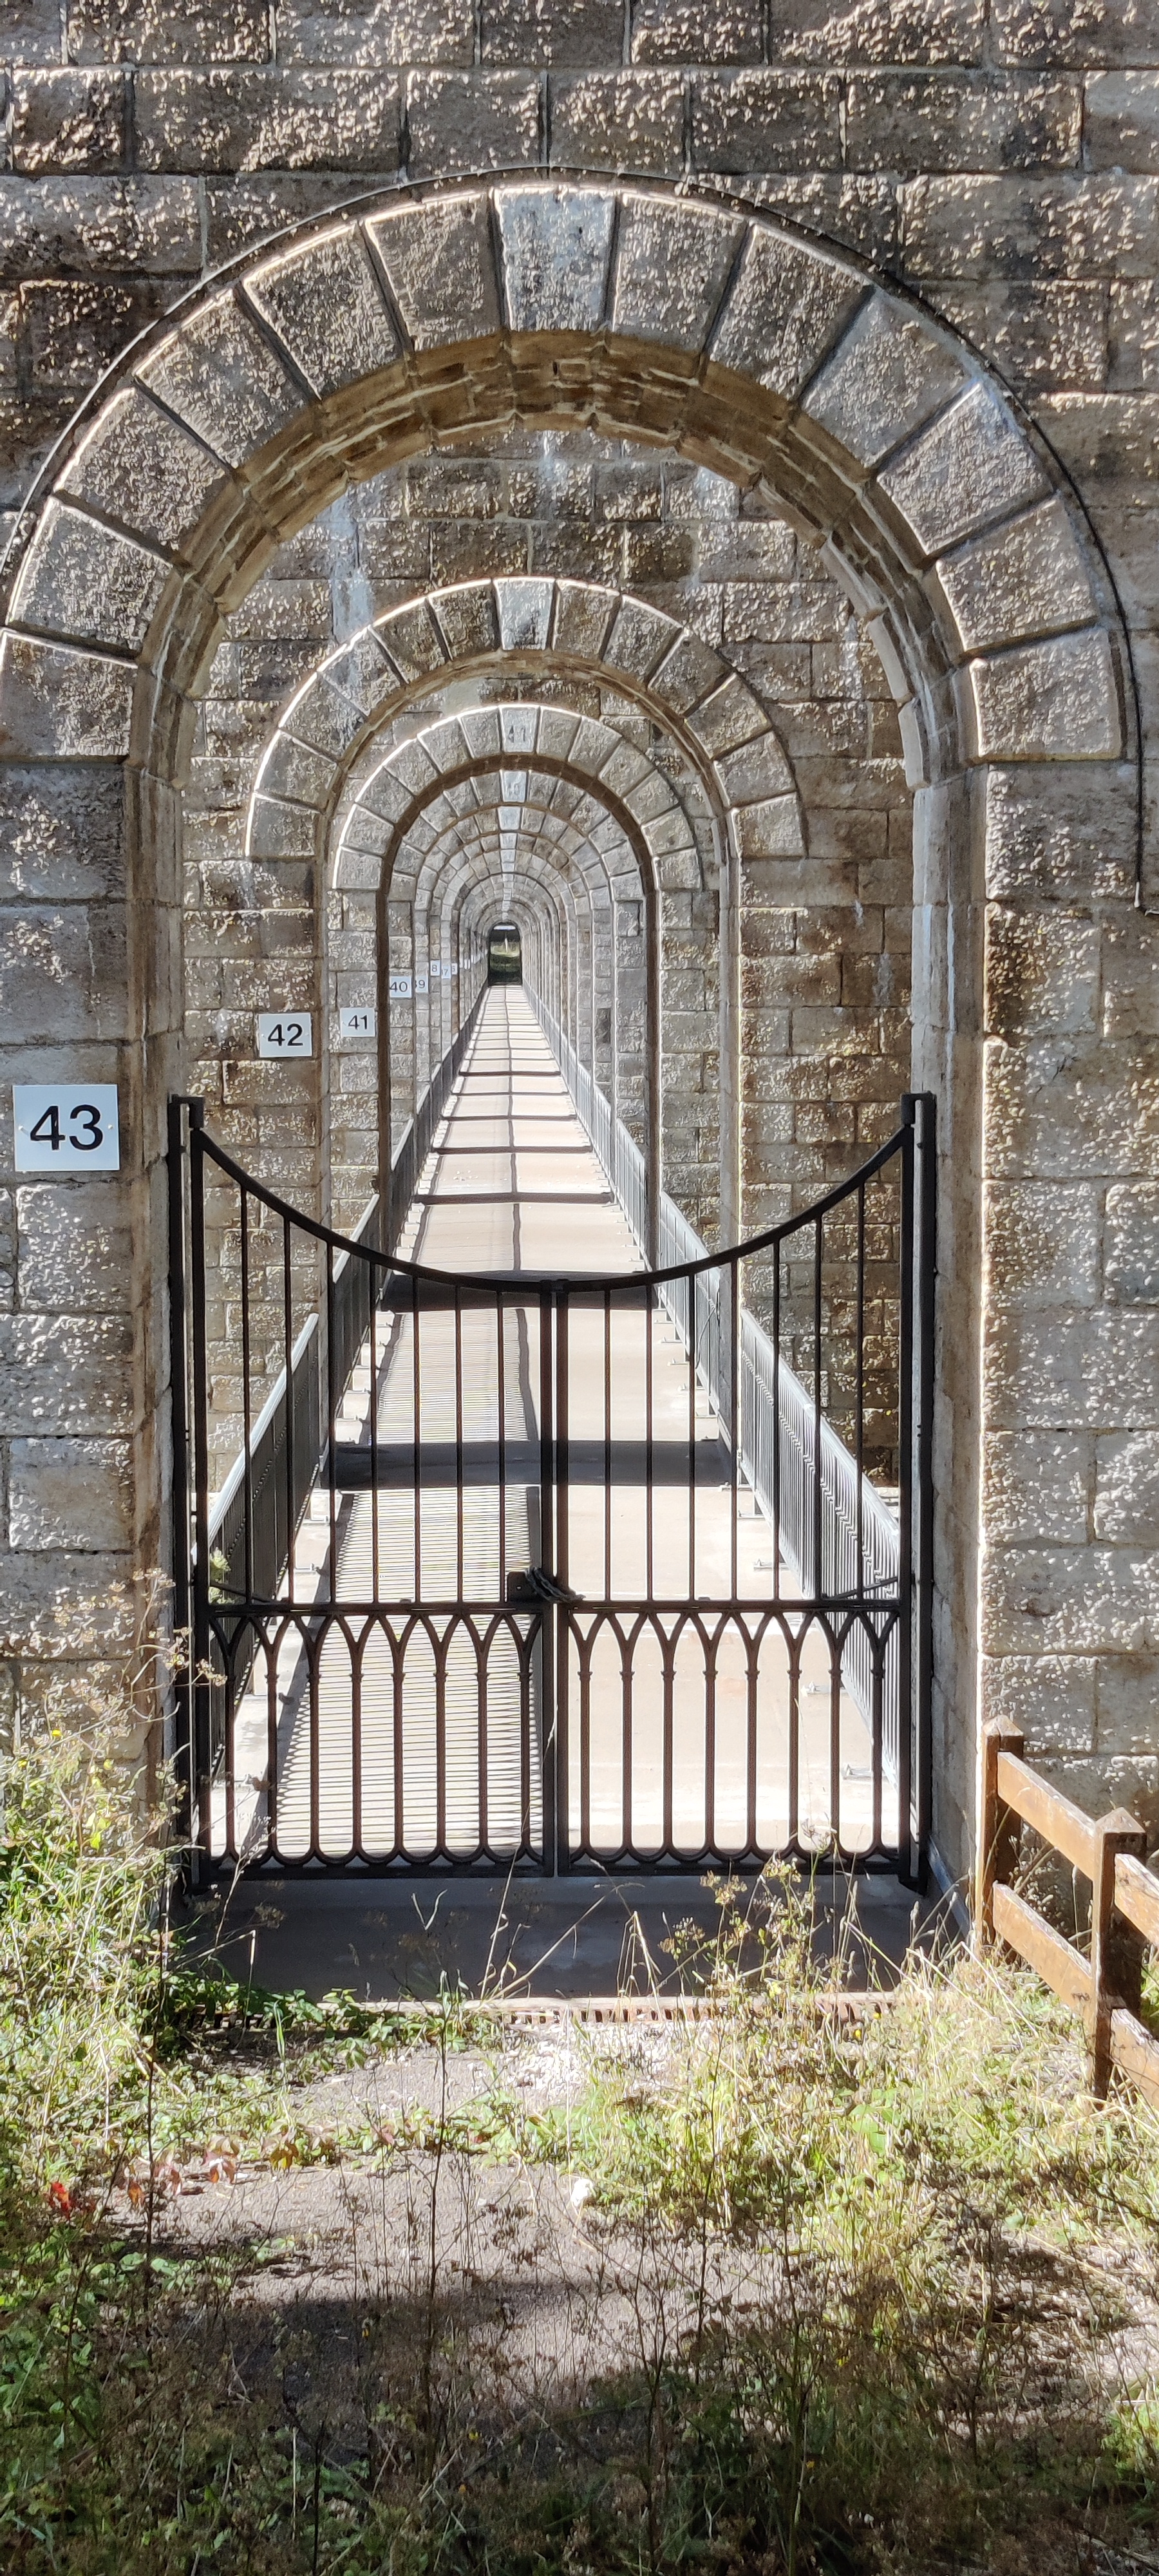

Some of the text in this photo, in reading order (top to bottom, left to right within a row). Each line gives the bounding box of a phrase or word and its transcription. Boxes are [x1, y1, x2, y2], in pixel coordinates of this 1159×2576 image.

[390, 981, 408, 992] 40
[348, 1014, 368, 1030] 41
[267, 1023, 303, 1046] 42
[30, 1104, 103, 1151] 43
